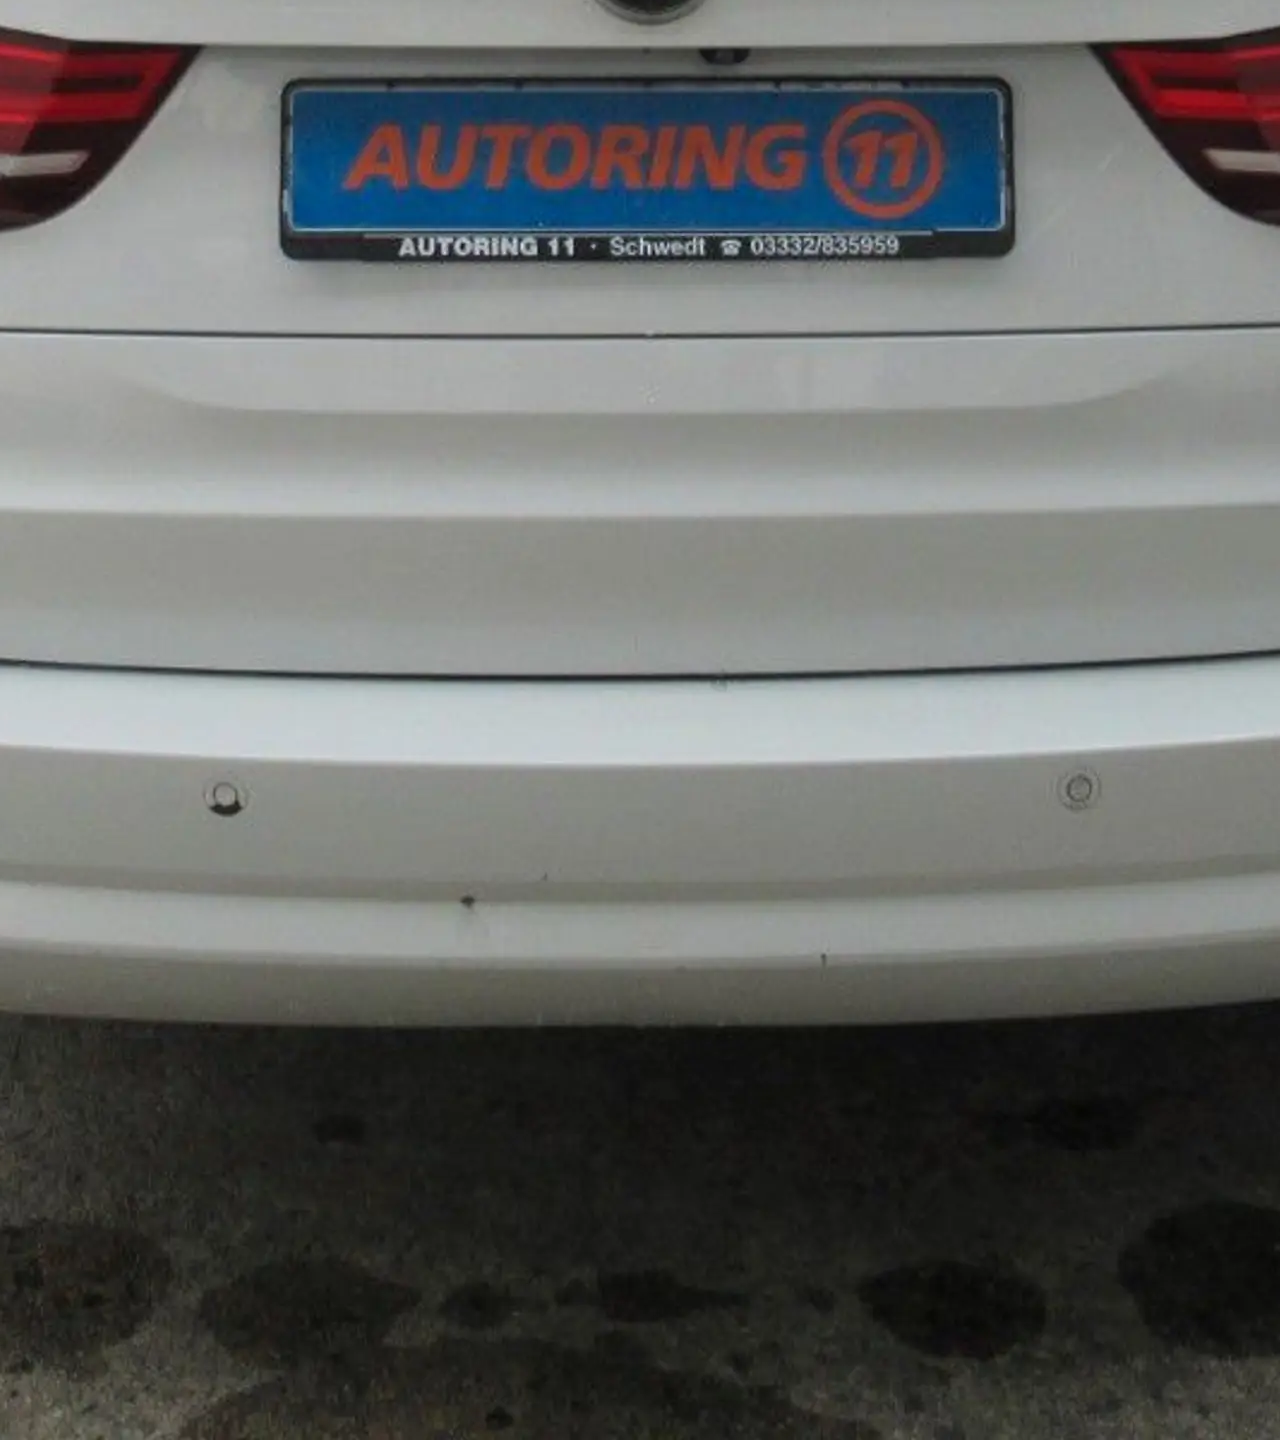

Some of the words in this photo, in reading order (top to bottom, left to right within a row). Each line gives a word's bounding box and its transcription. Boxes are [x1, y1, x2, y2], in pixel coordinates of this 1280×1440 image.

[342, 124, 808, 191] AUTORING
[842, 129, 919, 188] 11
[398, 236, 538, 257] AUTORING
[547, 236, 575, 257] 11
[609, 236, 707, 257] Schwedt
[749, 235, 901, 257] 03332/835959
